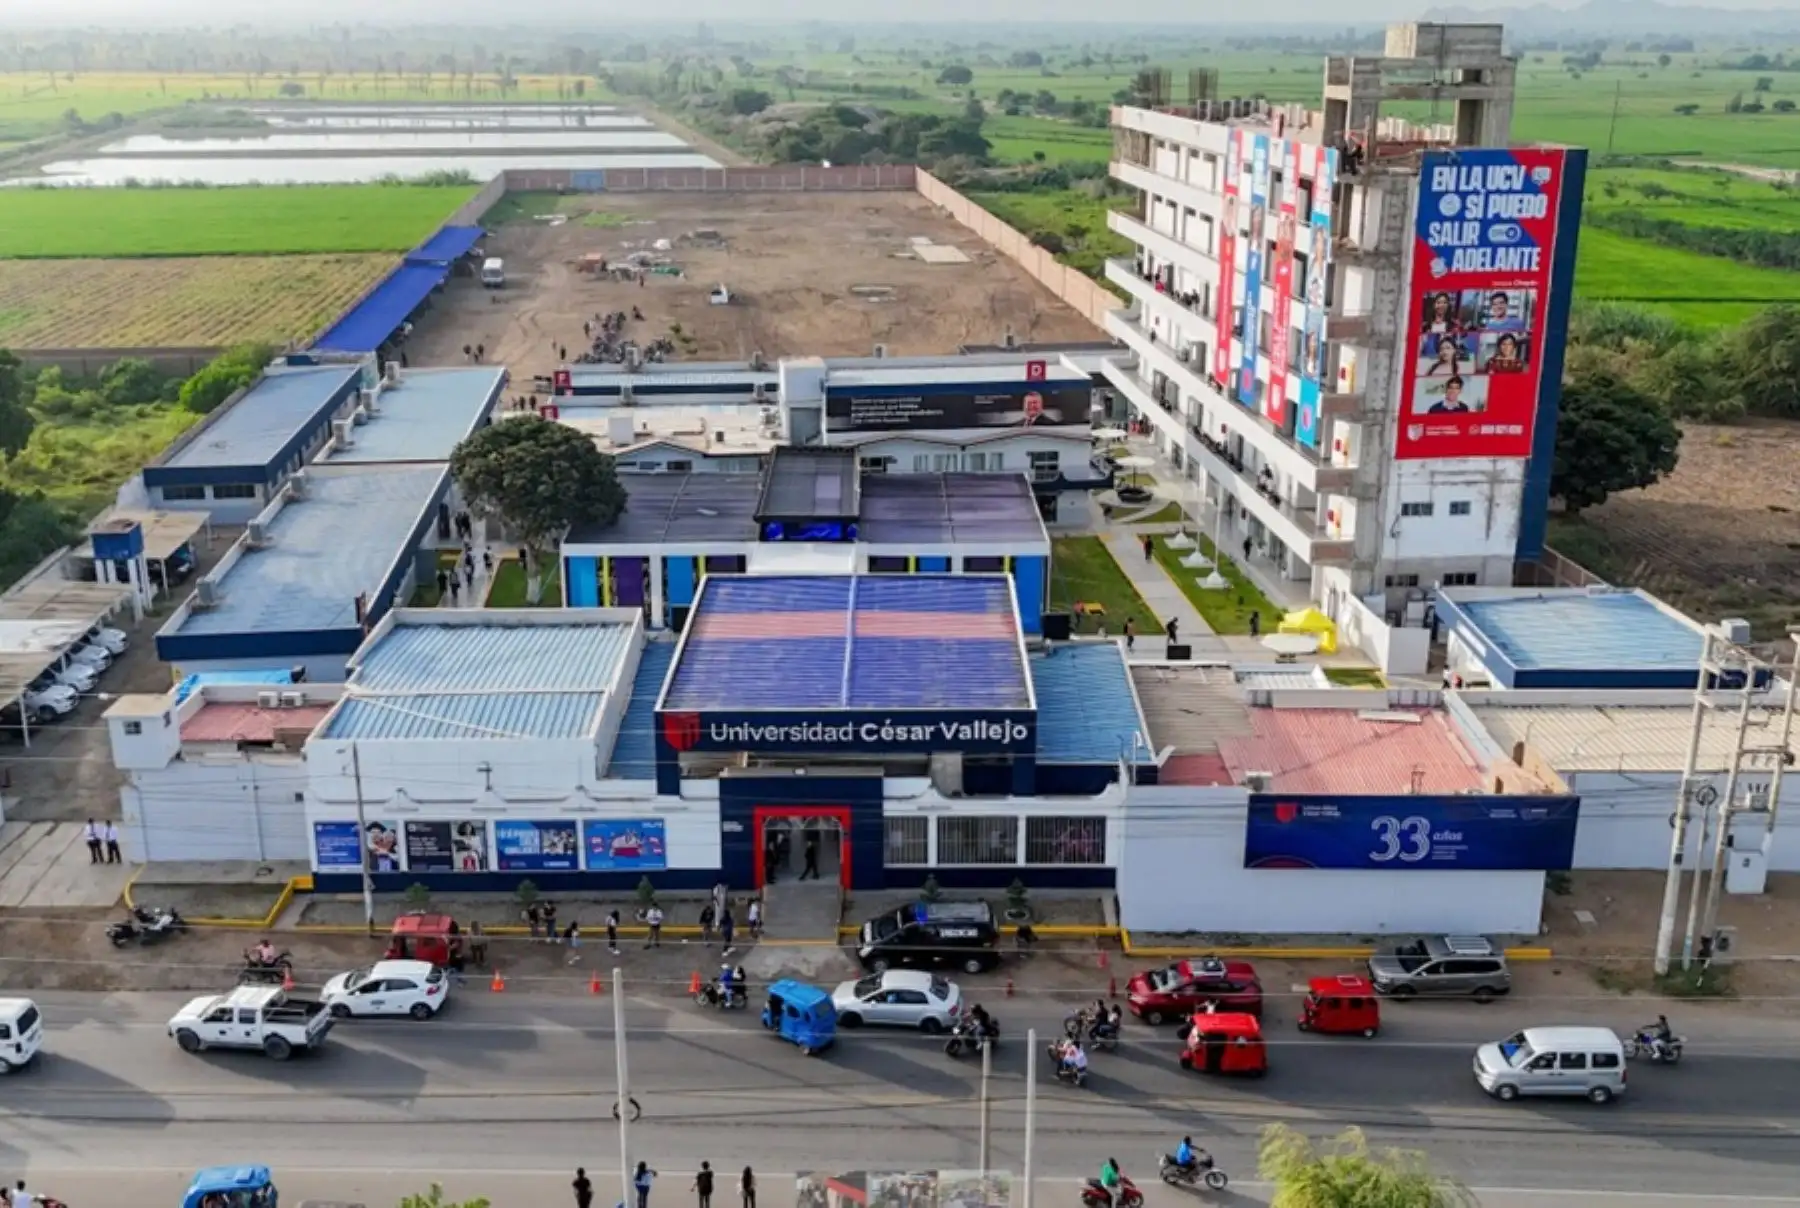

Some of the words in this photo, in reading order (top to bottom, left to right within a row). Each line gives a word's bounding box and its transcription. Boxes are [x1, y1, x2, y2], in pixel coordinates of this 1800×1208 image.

[1431, 165, 1458, 192] EN
[1459, 165, 1484, 192] LA
[1487, 165, 1526, 190] UCV
[1487, 193, 1547, 218] PUEDO
[1428, 221, 1480, 246] SALIR
[1452, 248, 1541, 272] ADELANTE
[1031, 364, 1043, 377] D
[710, 720, 854, 742] Universidad
[859, 718, 936, 742] César
[939, 719, 1028, 744] Vallejo
[1369, 815, 1430, 861] 33
